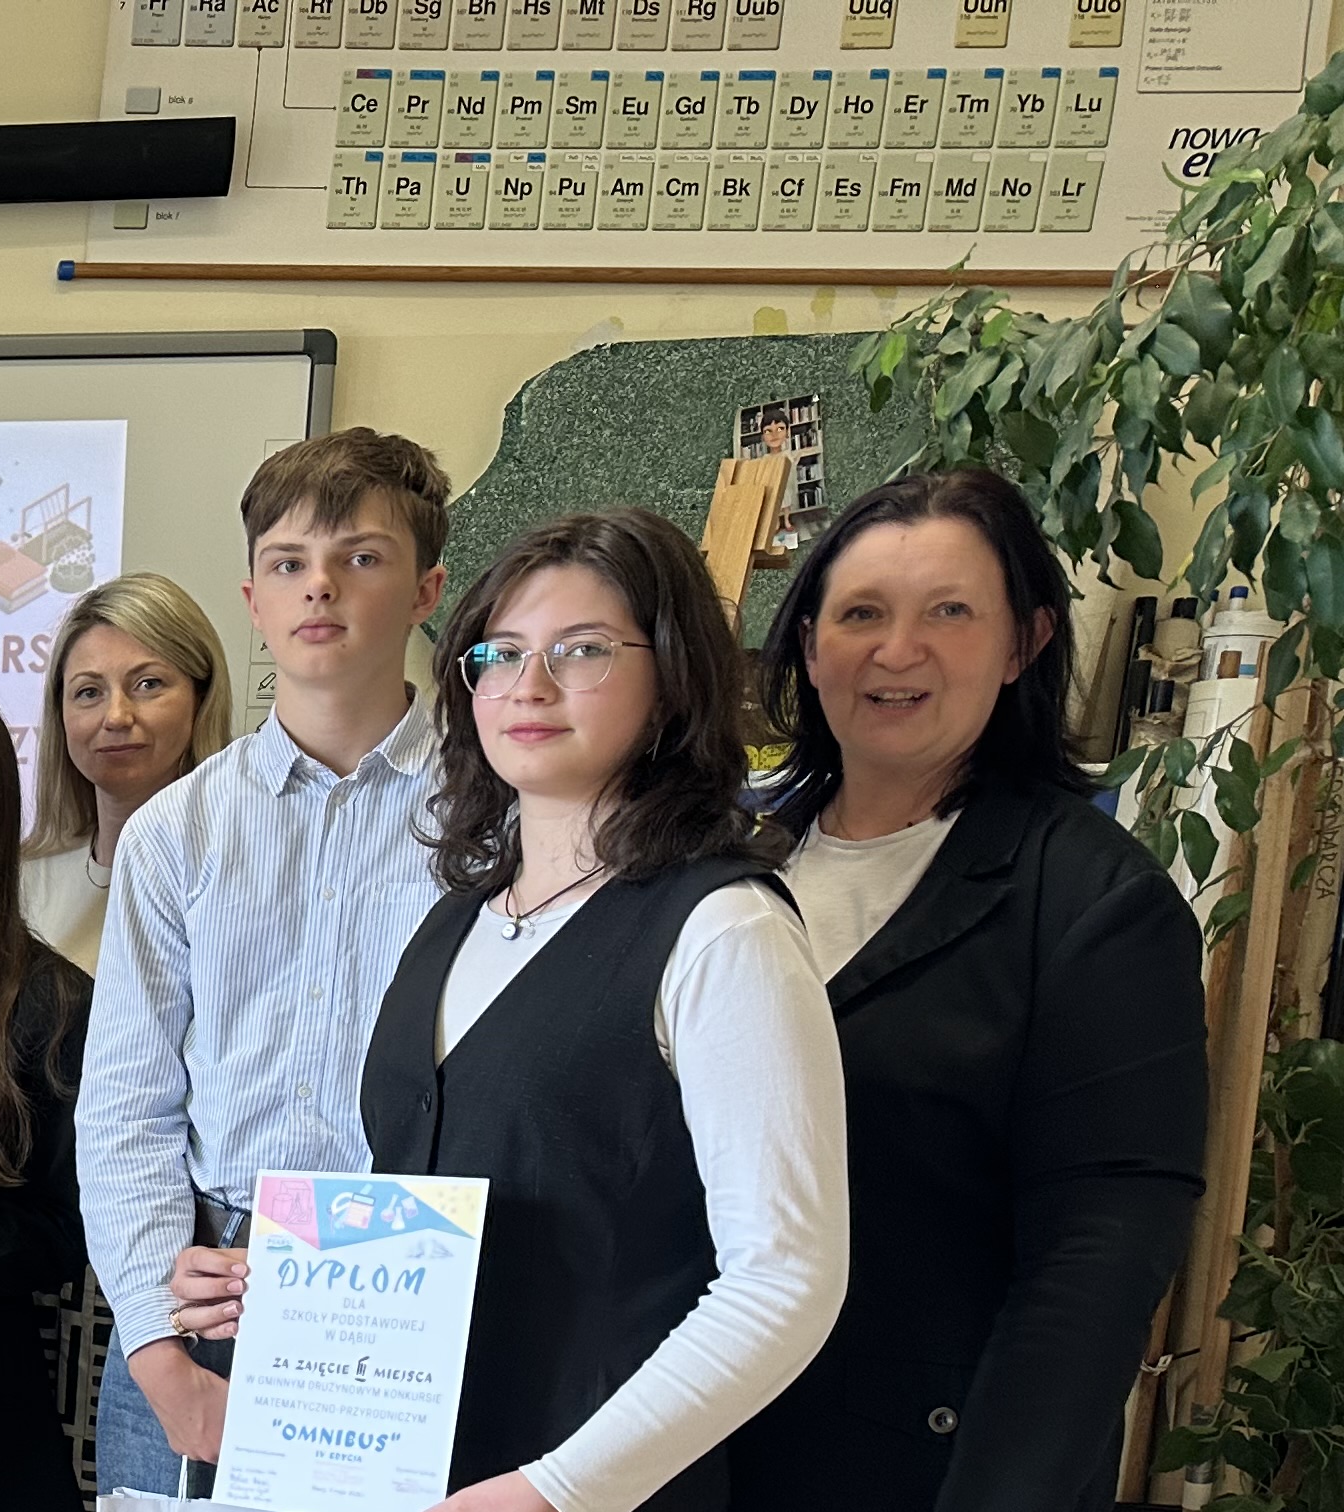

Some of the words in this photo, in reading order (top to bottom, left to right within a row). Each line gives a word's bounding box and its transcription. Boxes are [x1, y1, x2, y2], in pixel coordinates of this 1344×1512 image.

[352, 94, 377, 112] Ce
[407, 96, 429, 113] Pr
[457, 97, 485, 114] Nd
[511, 97, 542, 114] Pm
[566, 96, 596, 114] Sm
[623, 97, 648, 115] Eu
[676, 97, 705, 114] Gd
[734, 96, 759, 114] Tb
[788, 97, 818, 120] Dy
[844, 96, 873, 113] Ho
[904, 95, 928, 113] Er
[957, 95, 988, 112] Tm
[1018, 94, 1044, 112] Yb
[1075, 94, 1101, 112] Lu
[340, 177, 366, 194] Th
[396, 178, 420, 195] Pa
[456, 178, 470, 195] U
[503, 178, 532, 201] Np
[559, 178, 585, 195] Pu
[611, 179, 643, 195] Am
[666, 178, 698, 196] Cm
[723, 178, 750, 196] Bk
[781, 179, 804, 196] Cf
[835, 179, 861, 196] Es
[887, 179, 920, 196] Fm
[946, 178, 976, 196] Md
[1002, 178, 1031, 196] No
[1062, 178, 1085, 196] Lr
[278, 1258, 426, 1295] DYPLOM
[343, 1297, 365, 1309] DLA
[282, 1309, 327, 1325] SZKOŁY
[331, 1312, 424, 1332] PODSTAWOWEJ
[325, 1331, 337, 1341] W
[273, 1357, 289, 1369] ZA
[295, 1360, 349, 1376] ZAJĘCIE
[373, 1368, 432, 1383] MIEJSCA
